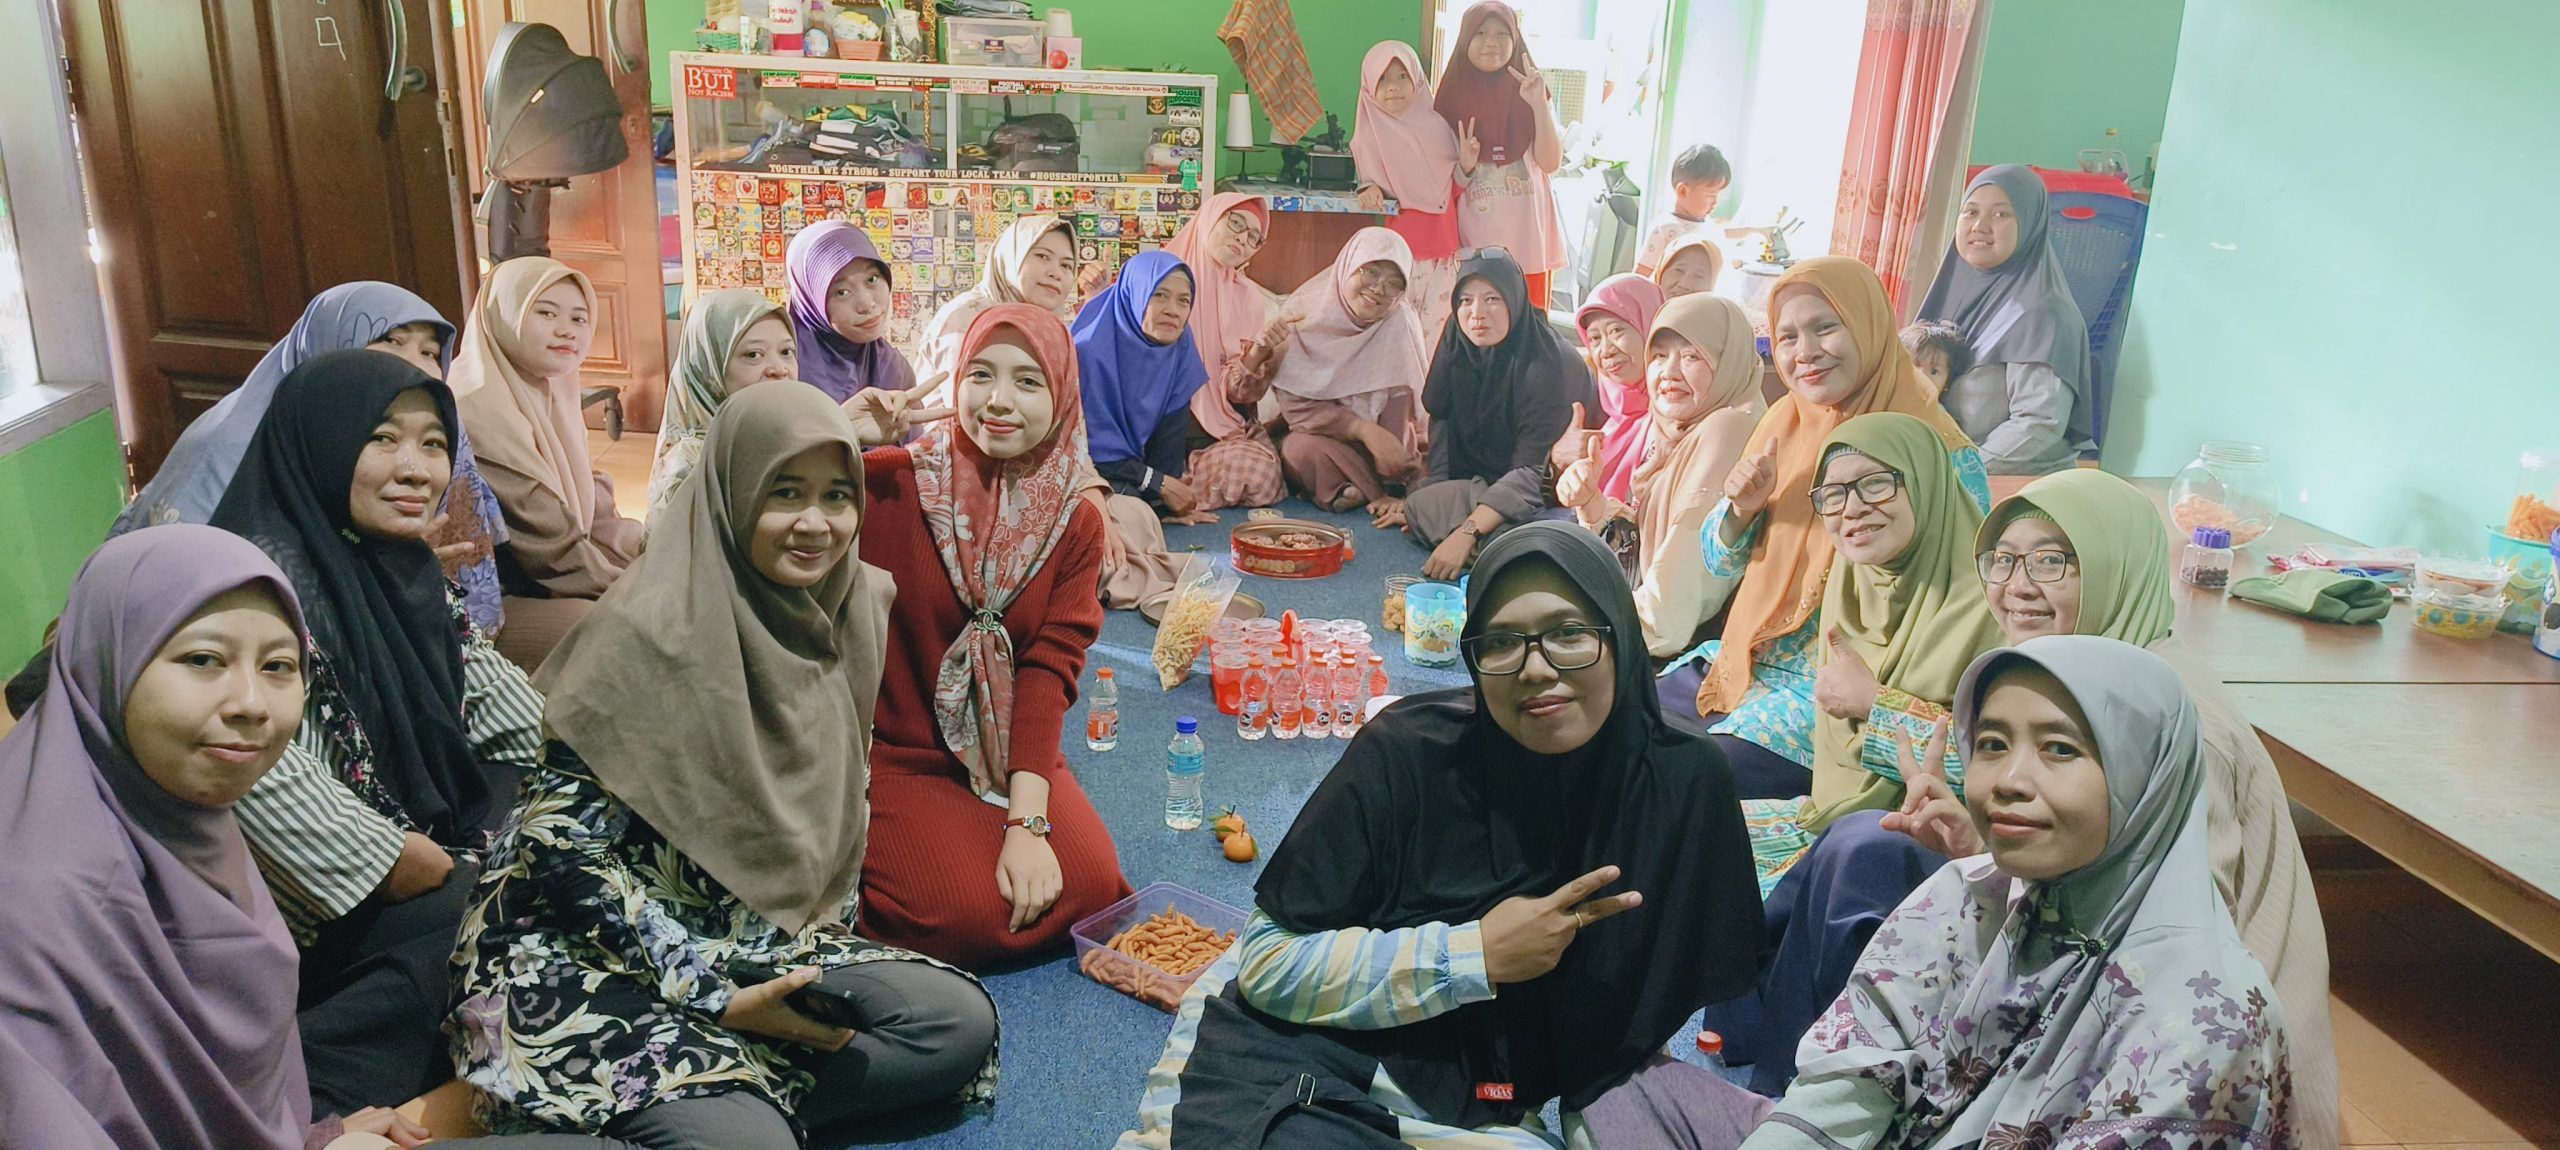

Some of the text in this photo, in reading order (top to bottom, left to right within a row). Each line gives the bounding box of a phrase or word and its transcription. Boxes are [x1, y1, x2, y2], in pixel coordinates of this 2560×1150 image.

[686, 67, 733, 90] BUT
[688, 87, 734, 97] NOT RACISM
[769, 163, 820, 175] TOGETHER
[823, 164, 838, 175] WE
[841, 165, 879, 177] STRONG
[889, 168, 932, 178] SUPPORT
[933, 169, 958, 178] YOUR
[960, 170, 990, 179] LOCAL
[992, 170, 1020, 180] TEAM
[1030, 172, 1119, 182] #HOUSESUPPORTER
